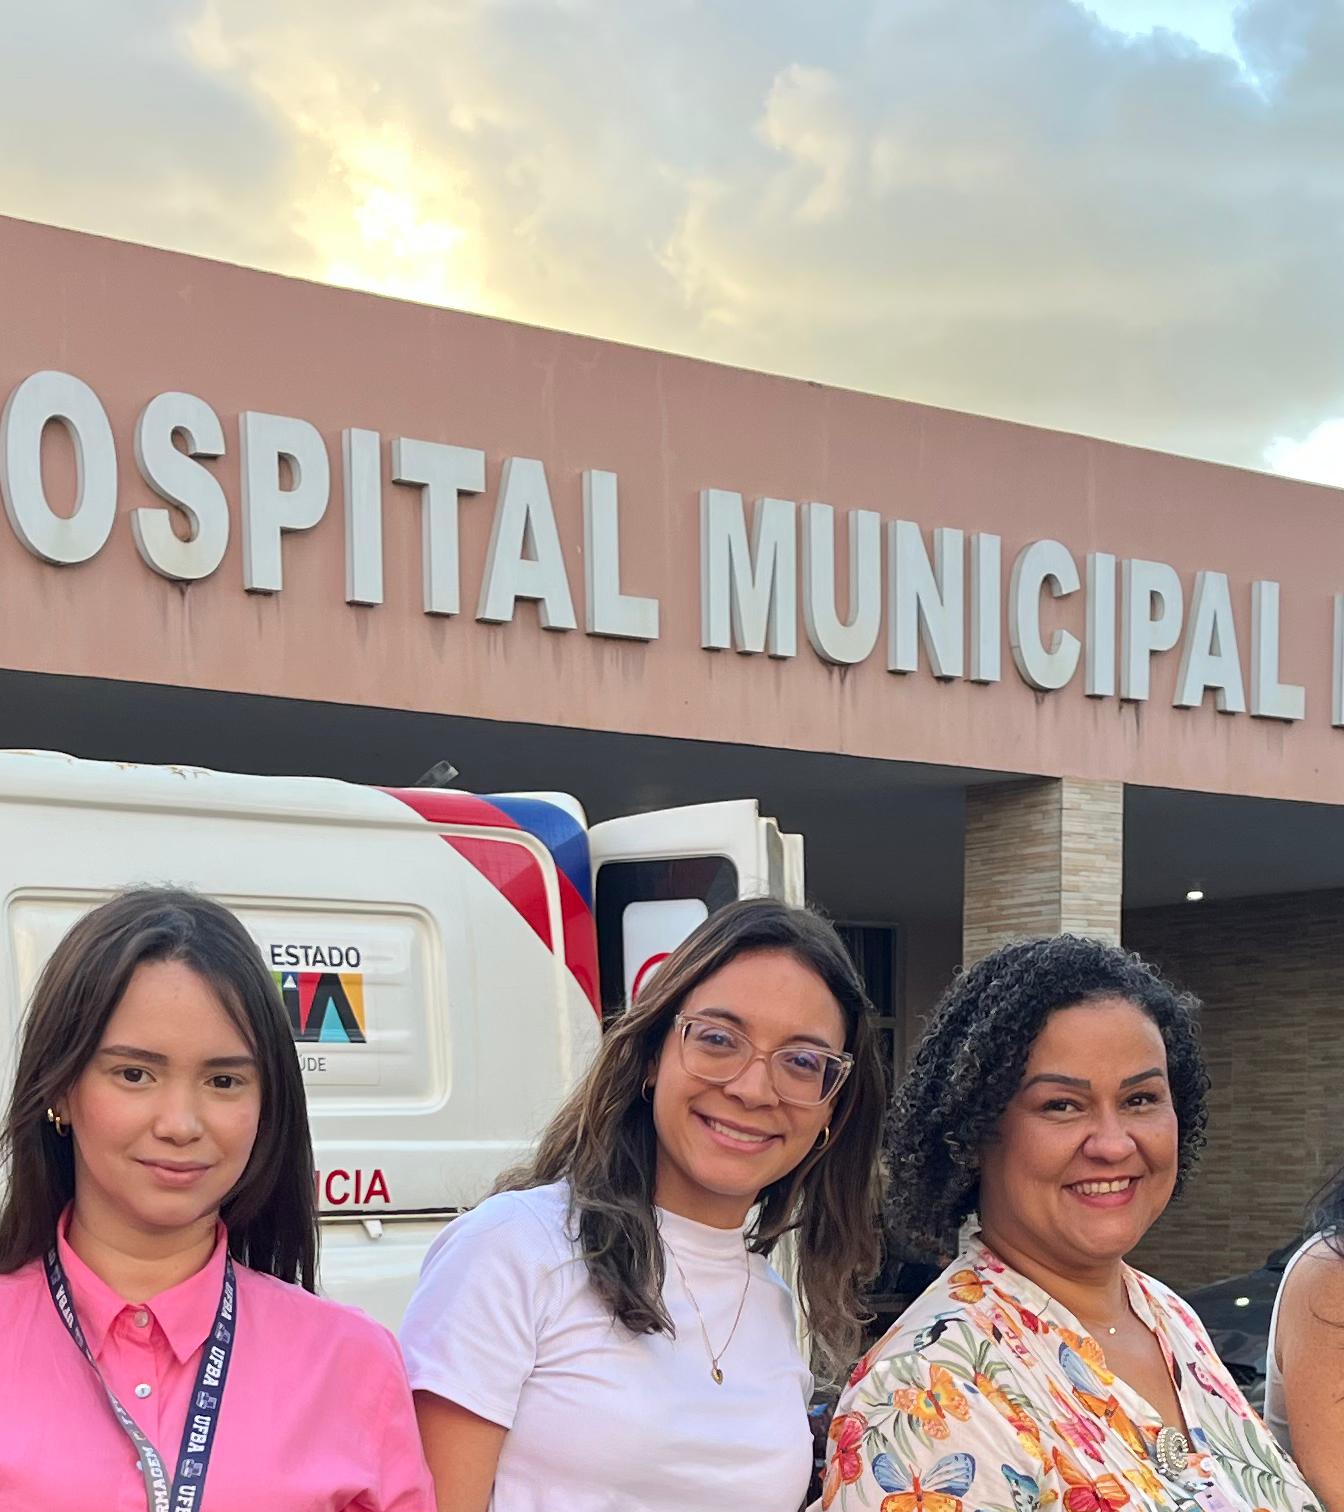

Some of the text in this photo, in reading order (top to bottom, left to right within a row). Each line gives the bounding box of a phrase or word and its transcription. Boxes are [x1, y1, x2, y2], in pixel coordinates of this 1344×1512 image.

[700, 488, 1305, 722] MUNICIPAL
[270, 944, 361, 968] ESTADO
[314, 1169, 391, 1206] CIA
[202, 1345, 225, 1386] UFBA
[187, 1414, 211, 1453] UFBA
